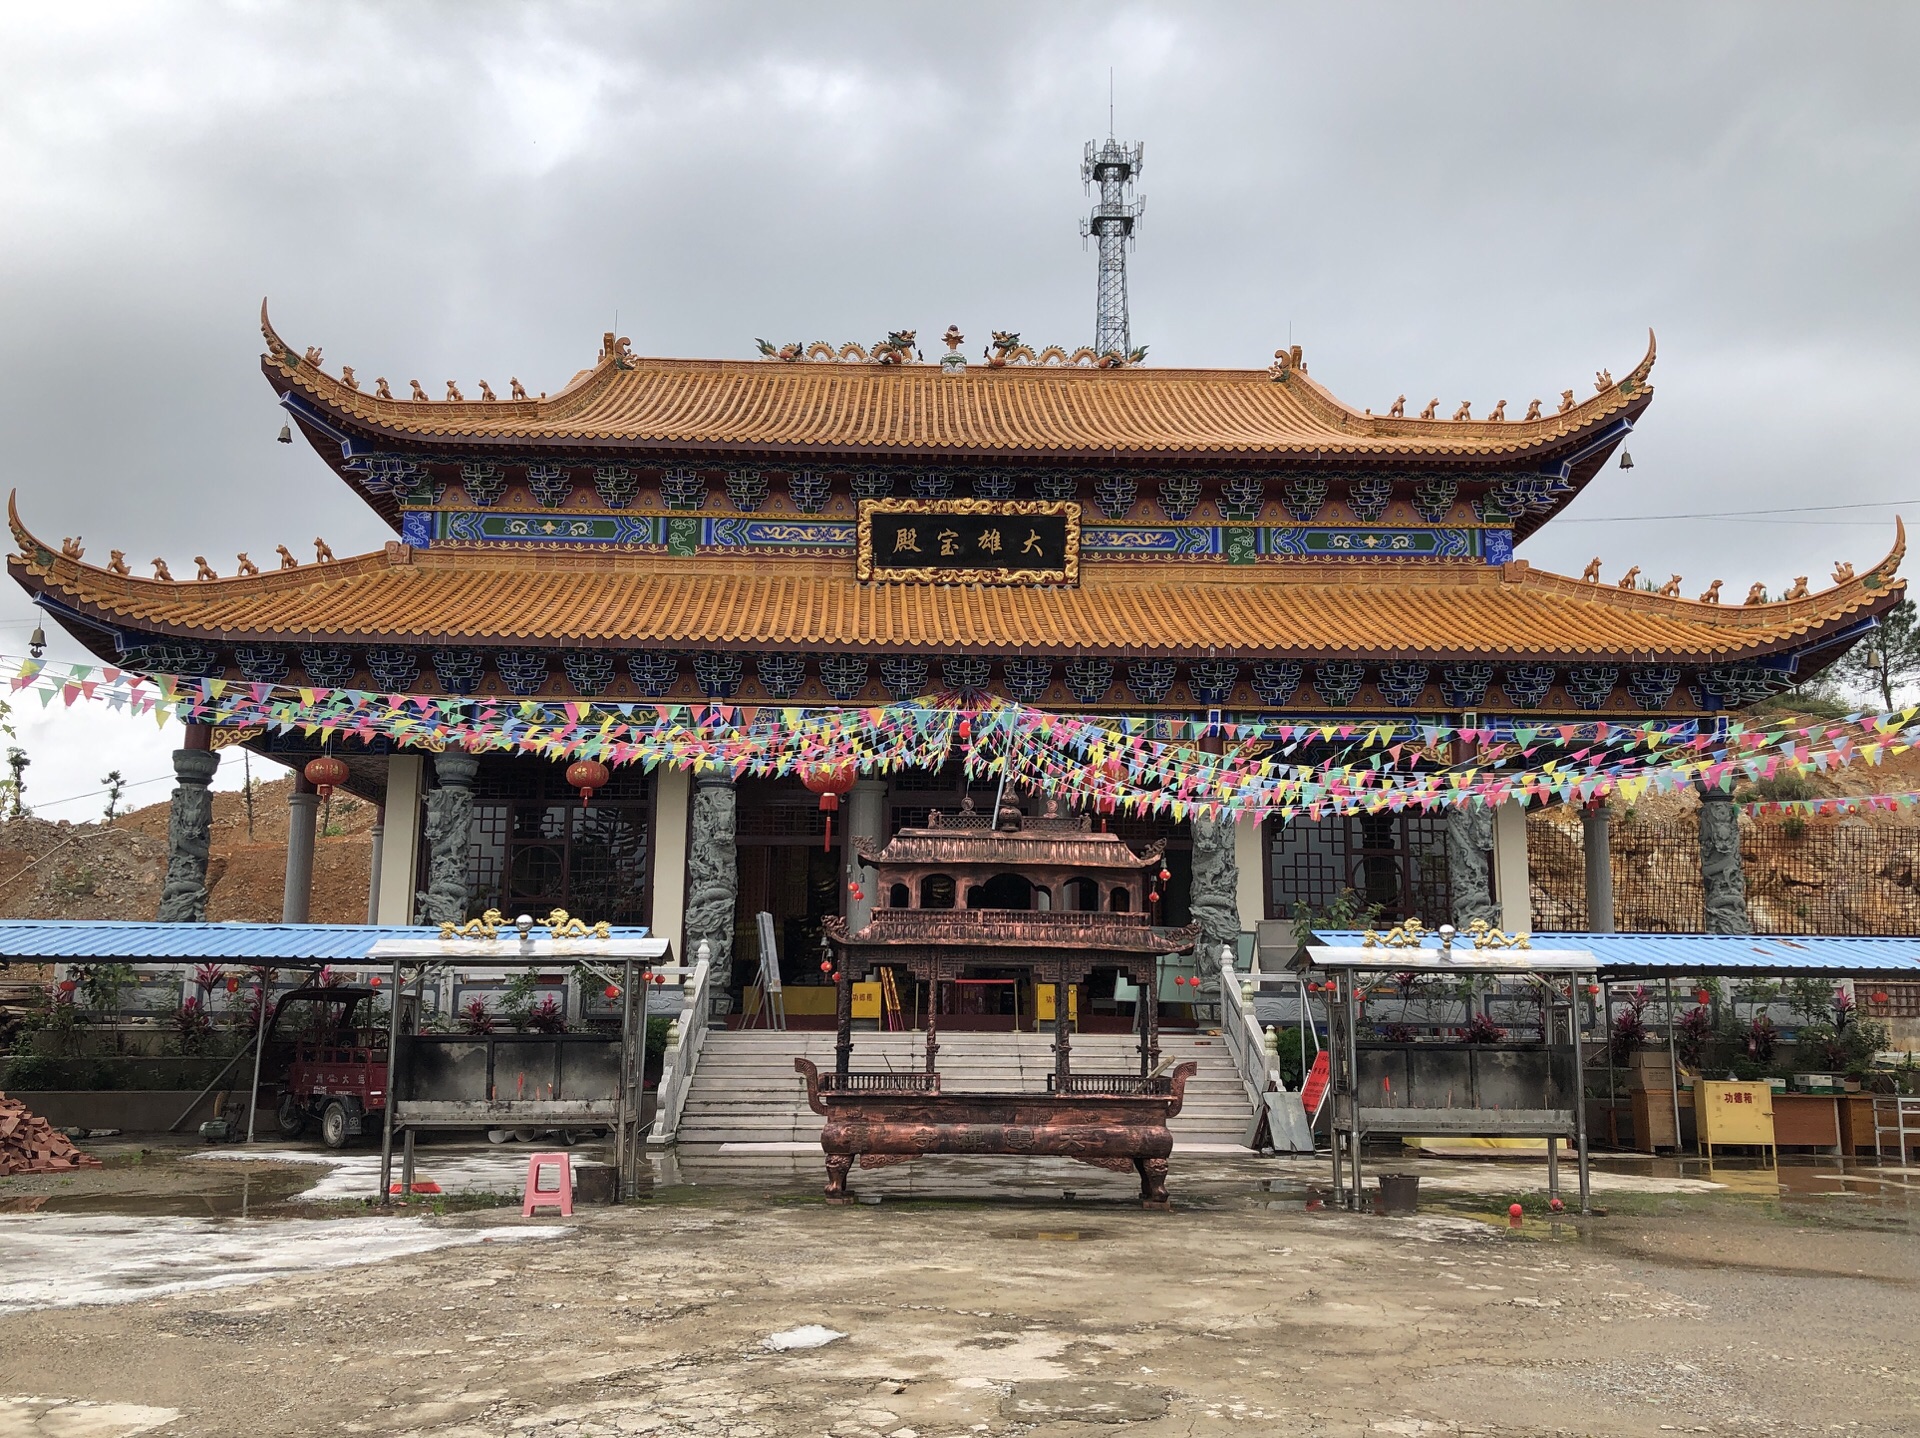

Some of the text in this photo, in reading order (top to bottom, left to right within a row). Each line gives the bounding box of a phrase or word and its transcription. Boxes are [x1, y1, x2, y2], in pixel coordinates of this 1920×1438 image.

[892, 527, 1044, 558] 大雄宝殿
[1724, 1091, 1753, 1104] 功德箱
